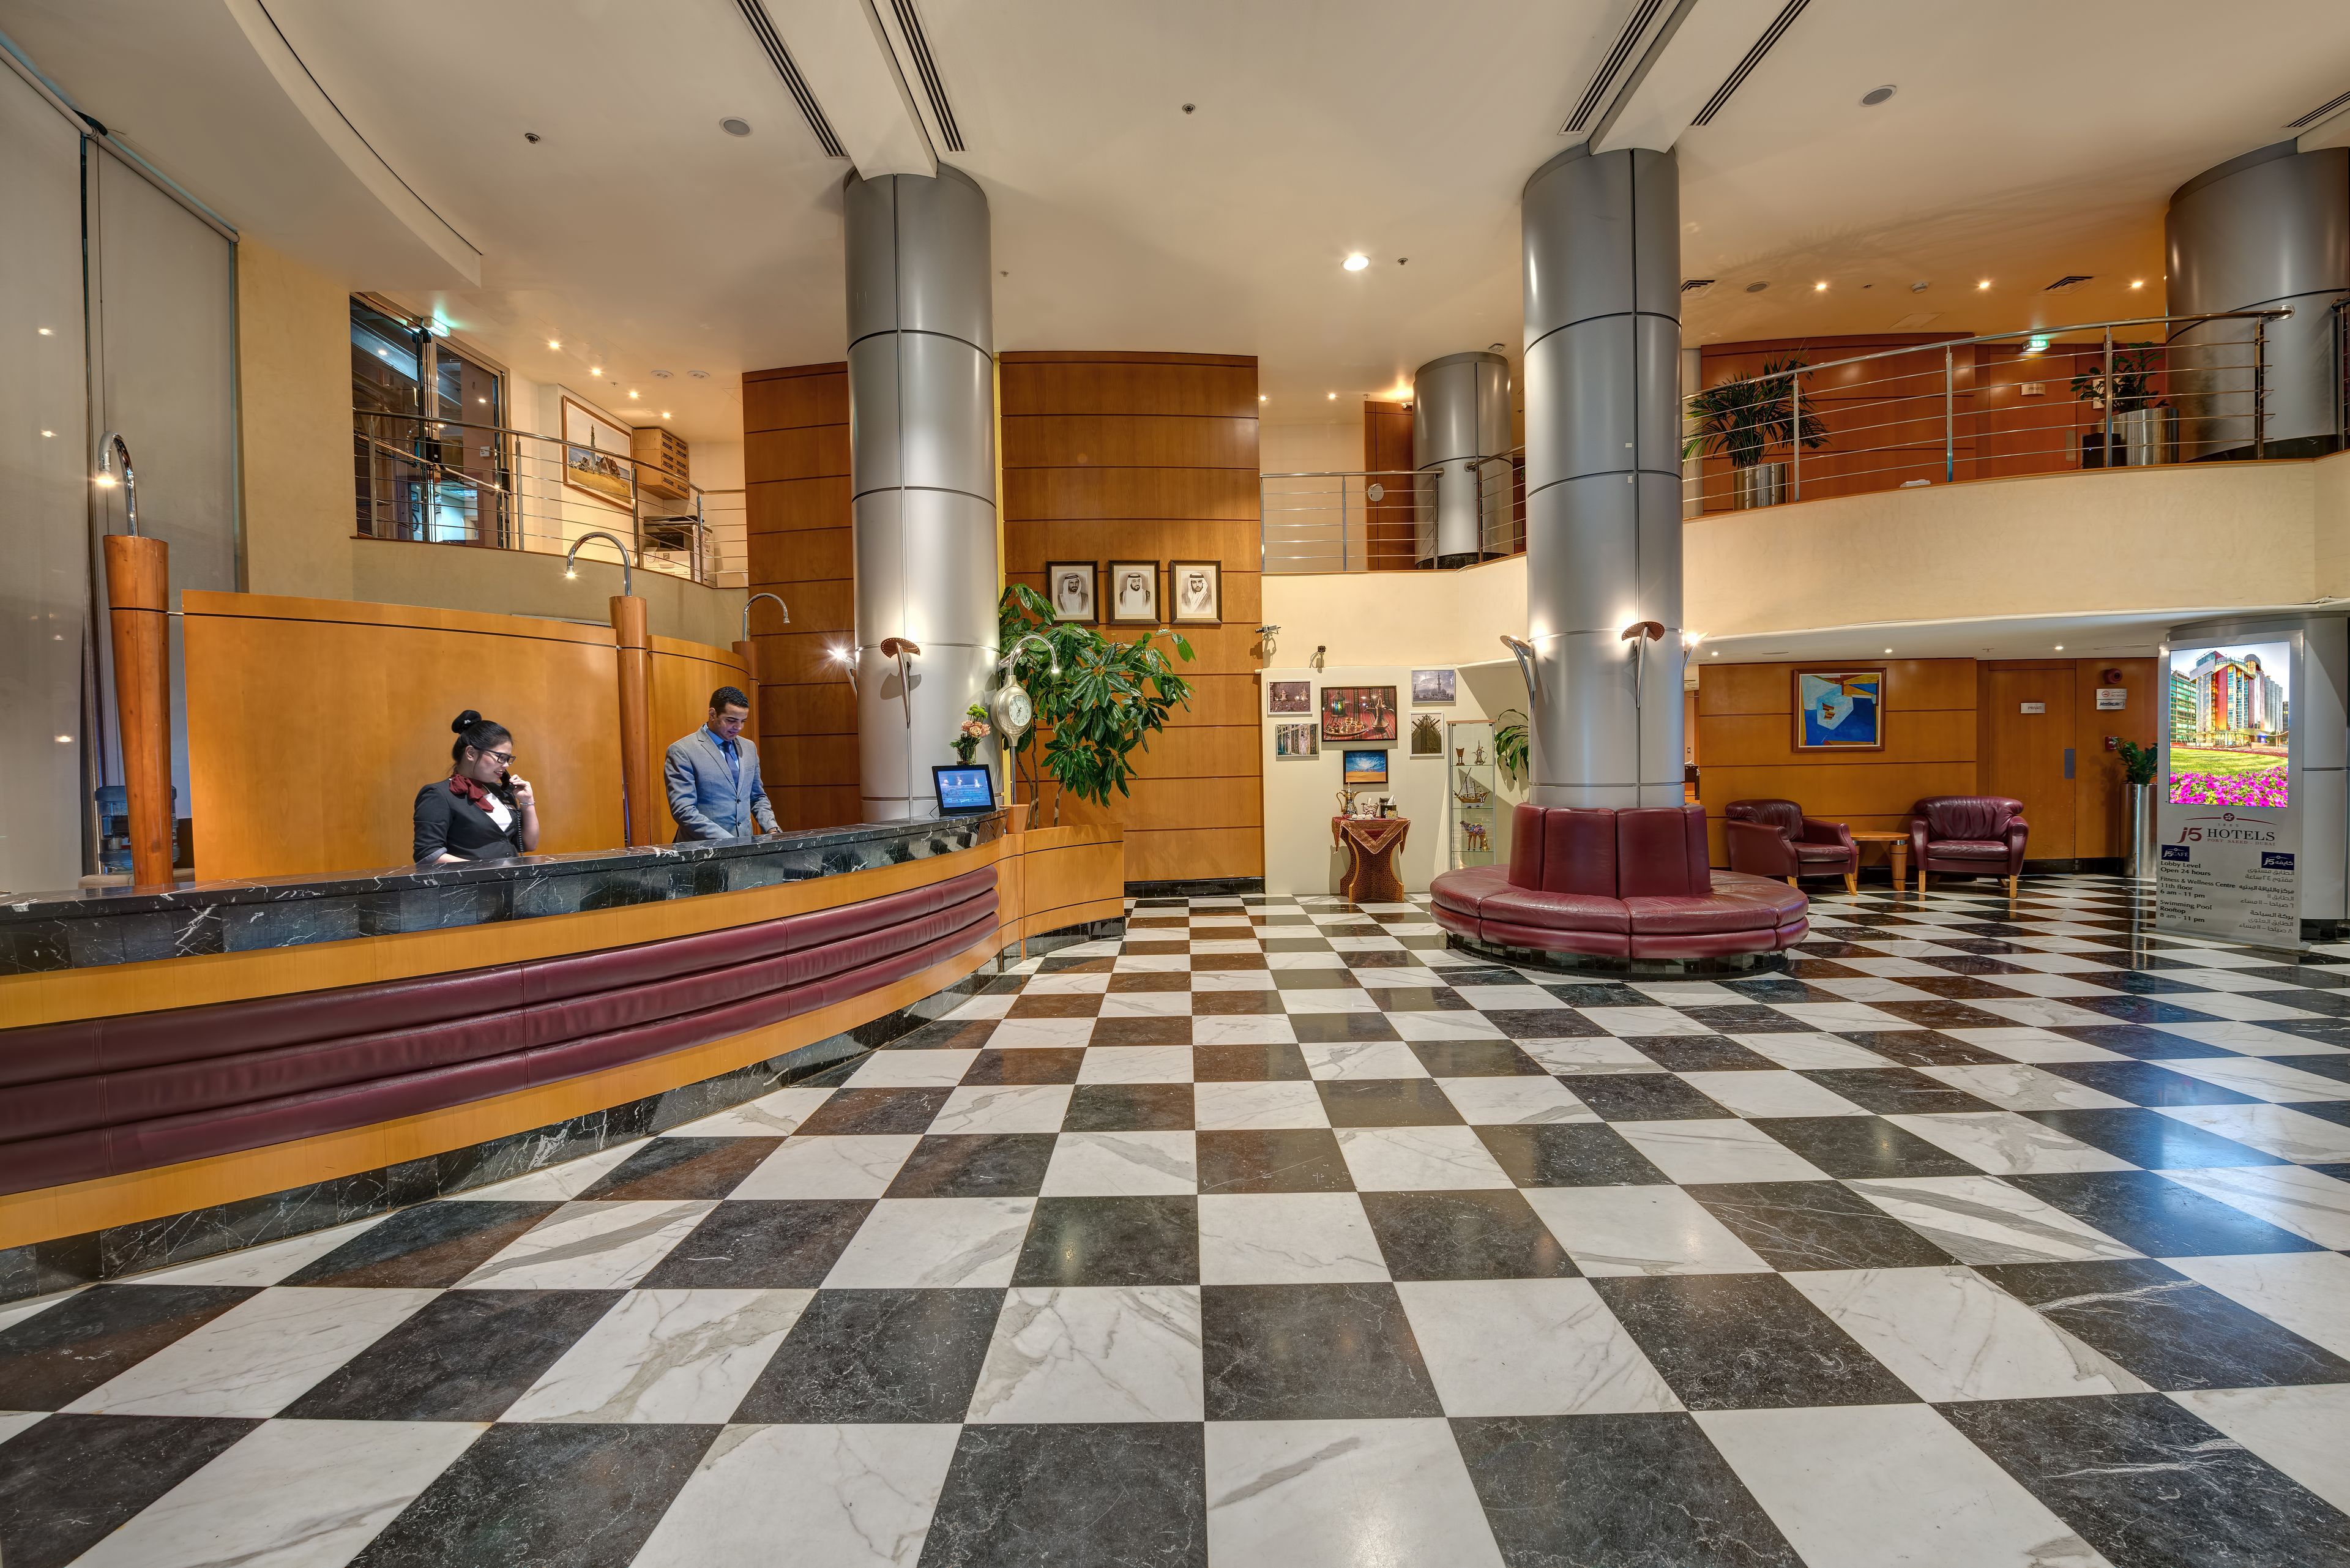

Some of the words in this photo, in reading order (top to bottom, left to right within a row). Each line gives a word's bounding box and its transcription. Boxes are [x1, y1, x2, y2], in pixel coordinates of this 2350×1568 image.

[2176, 827, 2203, 843] j5
[2207, 828, 2275, 842] HOTELS
[2160, 900, 2195, 909] Swimming
[2160, 906, 2186, 914] Rooftop
